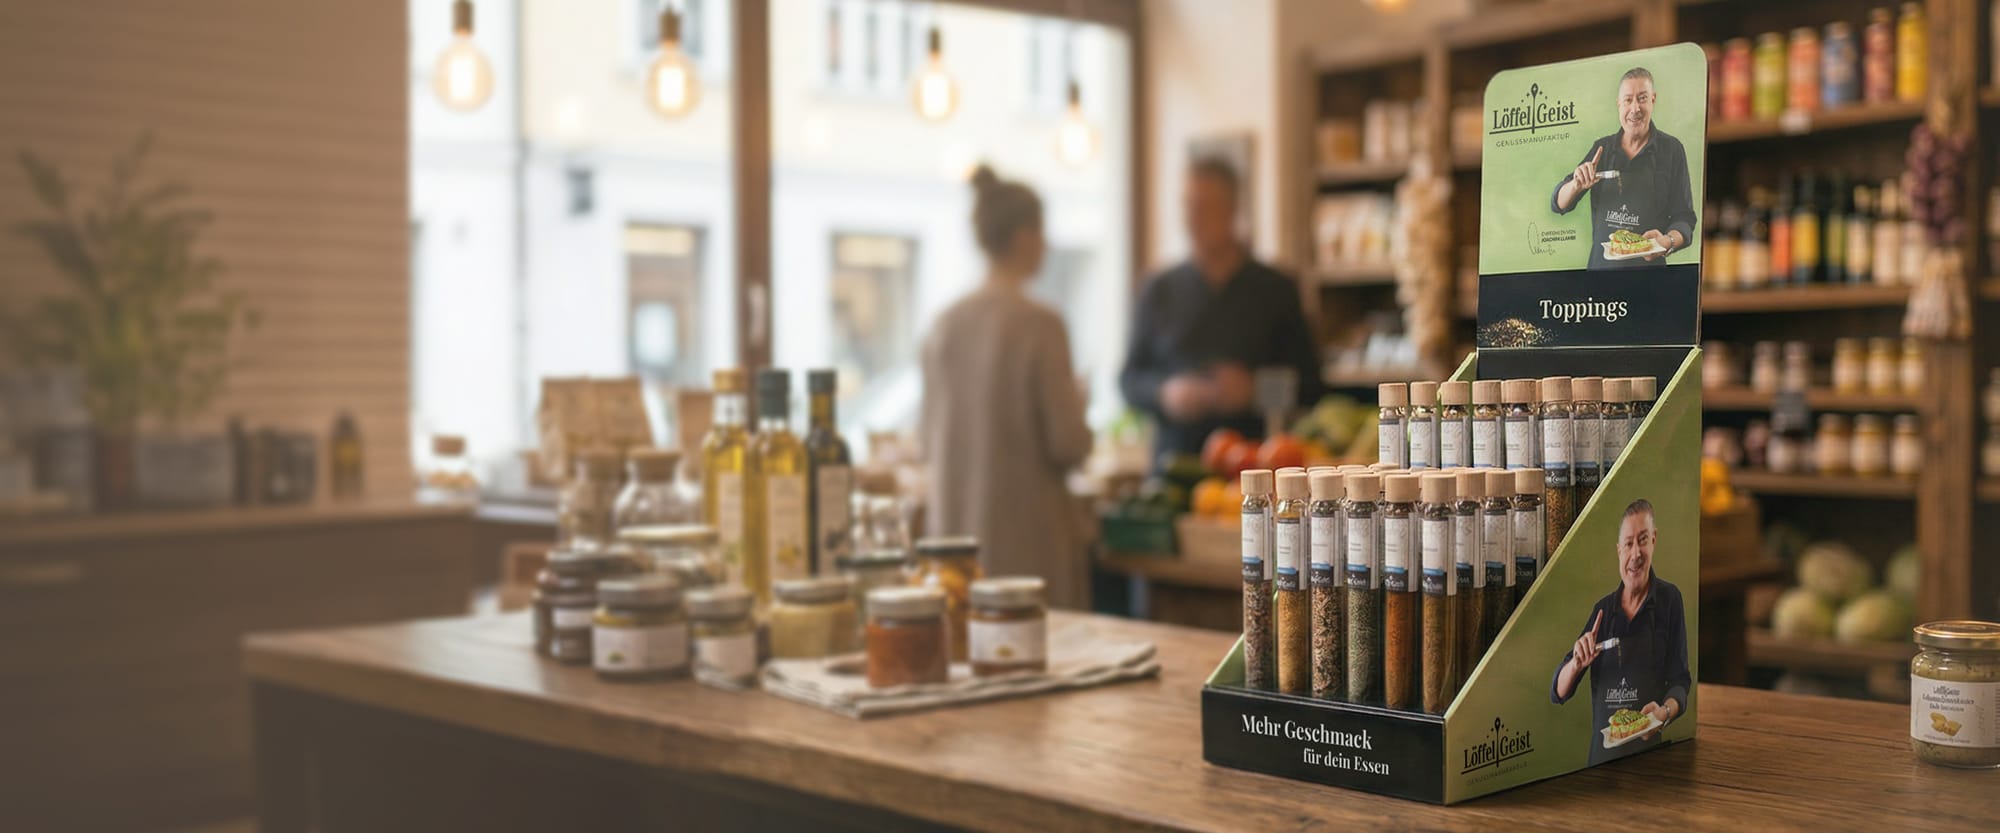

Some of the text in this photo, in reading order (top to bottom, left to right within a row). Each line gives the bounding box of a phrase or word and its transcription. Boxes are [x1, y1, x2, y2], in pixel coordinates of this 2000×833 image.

[1492, 100, 1576, 130] Löffel Geist
[1539, 297, 1629, 324] Toppings
[1241, 713, 1373, 751] Mehr Geschmack
[1303, 746, 1390, 777] für dein Essen
[1464, 730, 1532, 769] Löffel Geist
